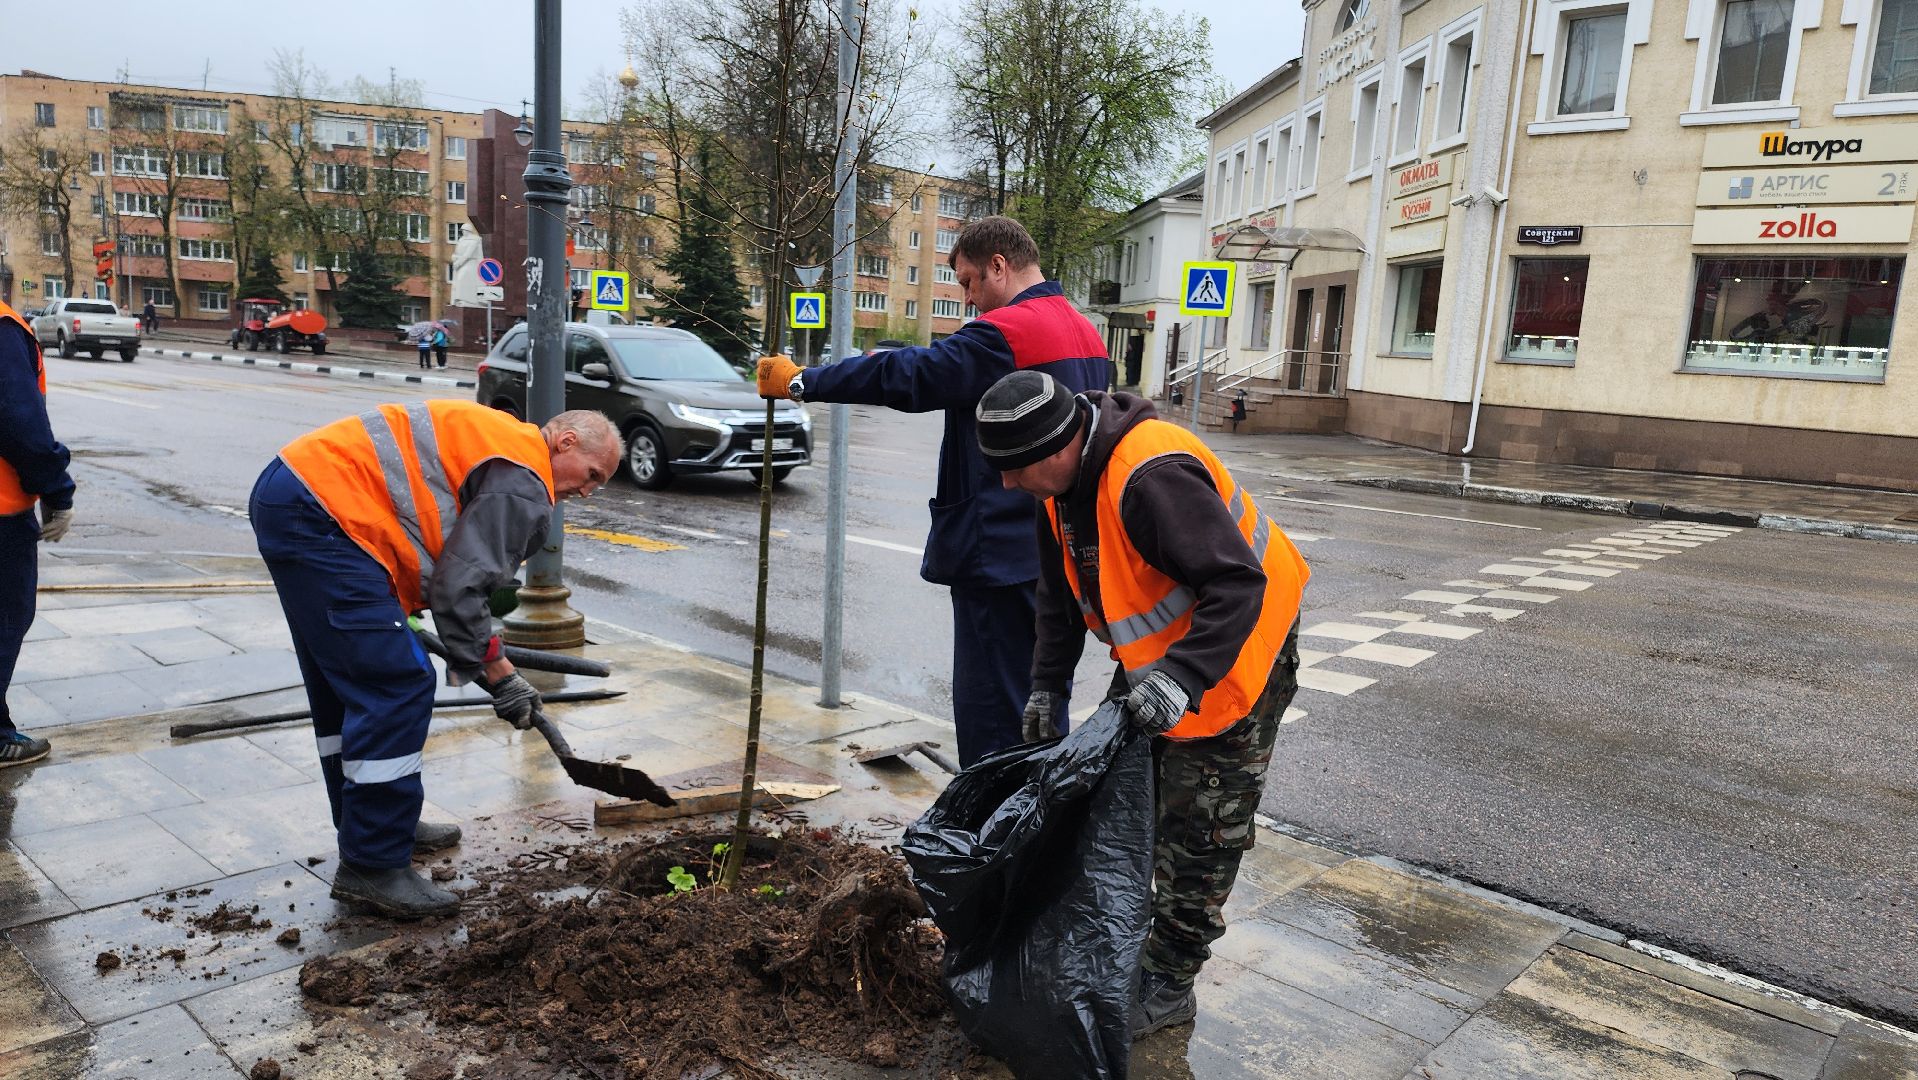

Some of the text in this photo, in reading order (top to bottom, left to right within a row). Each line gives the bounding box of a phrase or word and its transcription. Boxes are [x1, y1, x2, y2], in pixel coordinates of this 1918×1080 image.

[1759, 131, 1862, 161] Шатура
[1760, 174, 1830, 190] АРТИС
[1878, 172, 1897, 195] 2
[1401, 201, 1431, 219] КУХНИ
[1758, 213, 1837, 238] zolla
